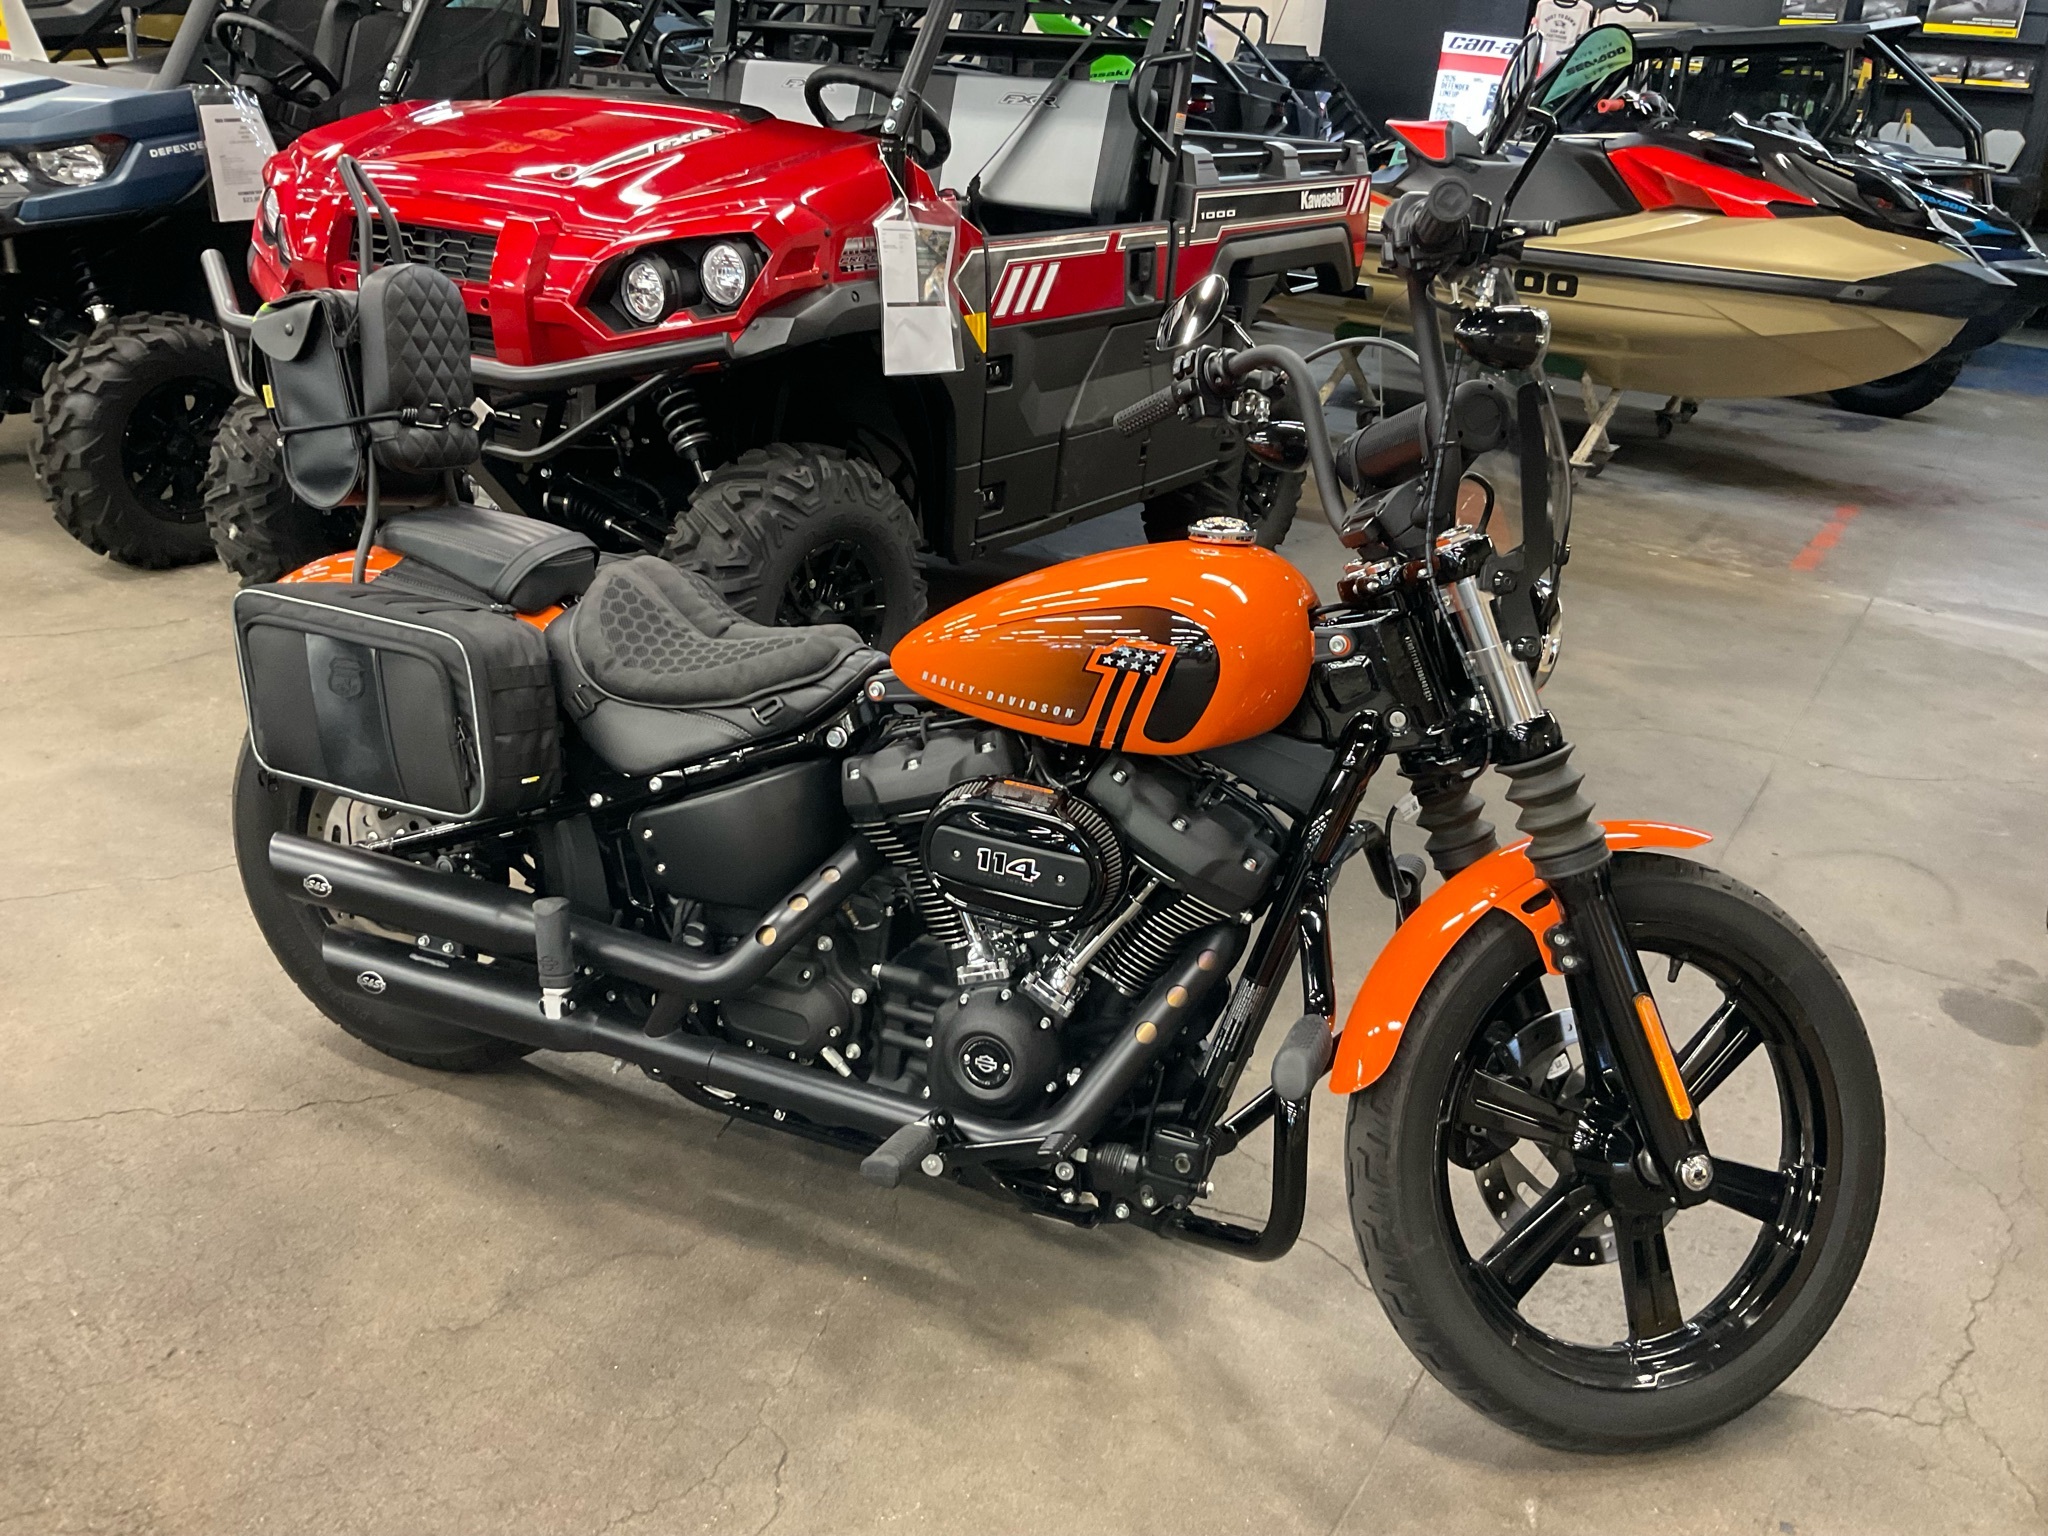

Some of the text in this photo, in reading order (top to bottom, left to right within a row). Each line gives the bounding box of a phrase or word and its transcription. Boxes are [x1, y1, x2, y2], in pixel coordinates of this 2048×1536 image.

[1448, 36, 1518, 55] can-a
[1090, 69, 1130, 78] asaki
[149, 140, 205, 158] DEFENDE
[1300, 187, 1344, 210] Kawasaki
[1200, 209, 1236, 220] 1000
[1510, 268, 1579, 298] 00
[921, 670, 1074, 719] HARLEY-DAVIDSON
[977, 847, 1041, 882] 114
[307, 879, 328, 892] S&S
[361, 976, 382, 989] S&S
